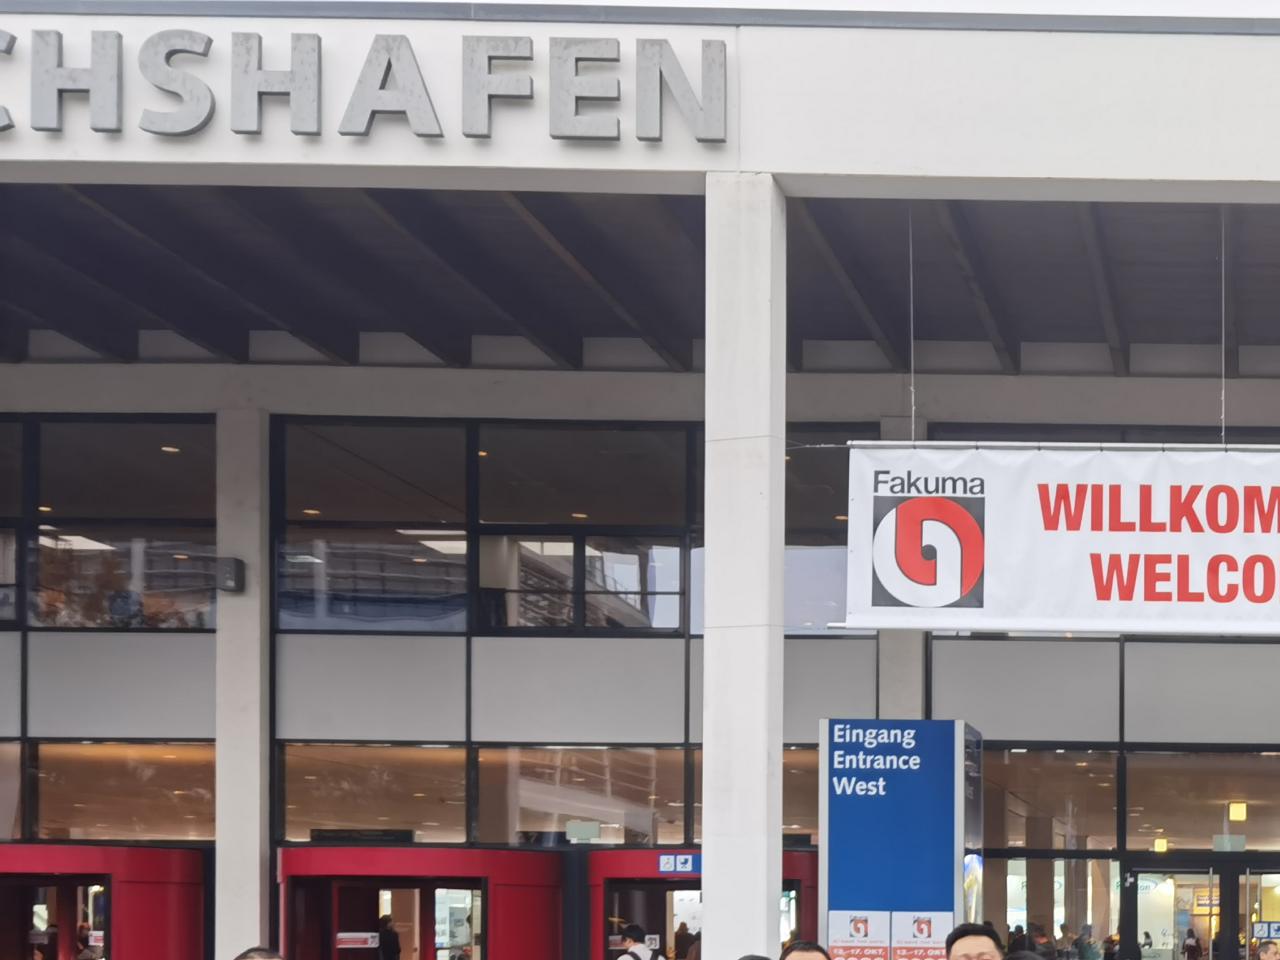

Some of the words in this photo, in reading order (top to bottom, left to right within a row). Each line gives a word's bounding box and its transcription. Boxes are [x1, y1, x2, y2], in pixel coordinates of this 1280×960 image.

[0, 29, 727, 143] HSHAFEN
[873, 470, 985, 495] Fakuma
[833, 724, 916, 748] Eingang
[833, 750, 921, 769] Entrance
[832, 776, 886, 795] West
